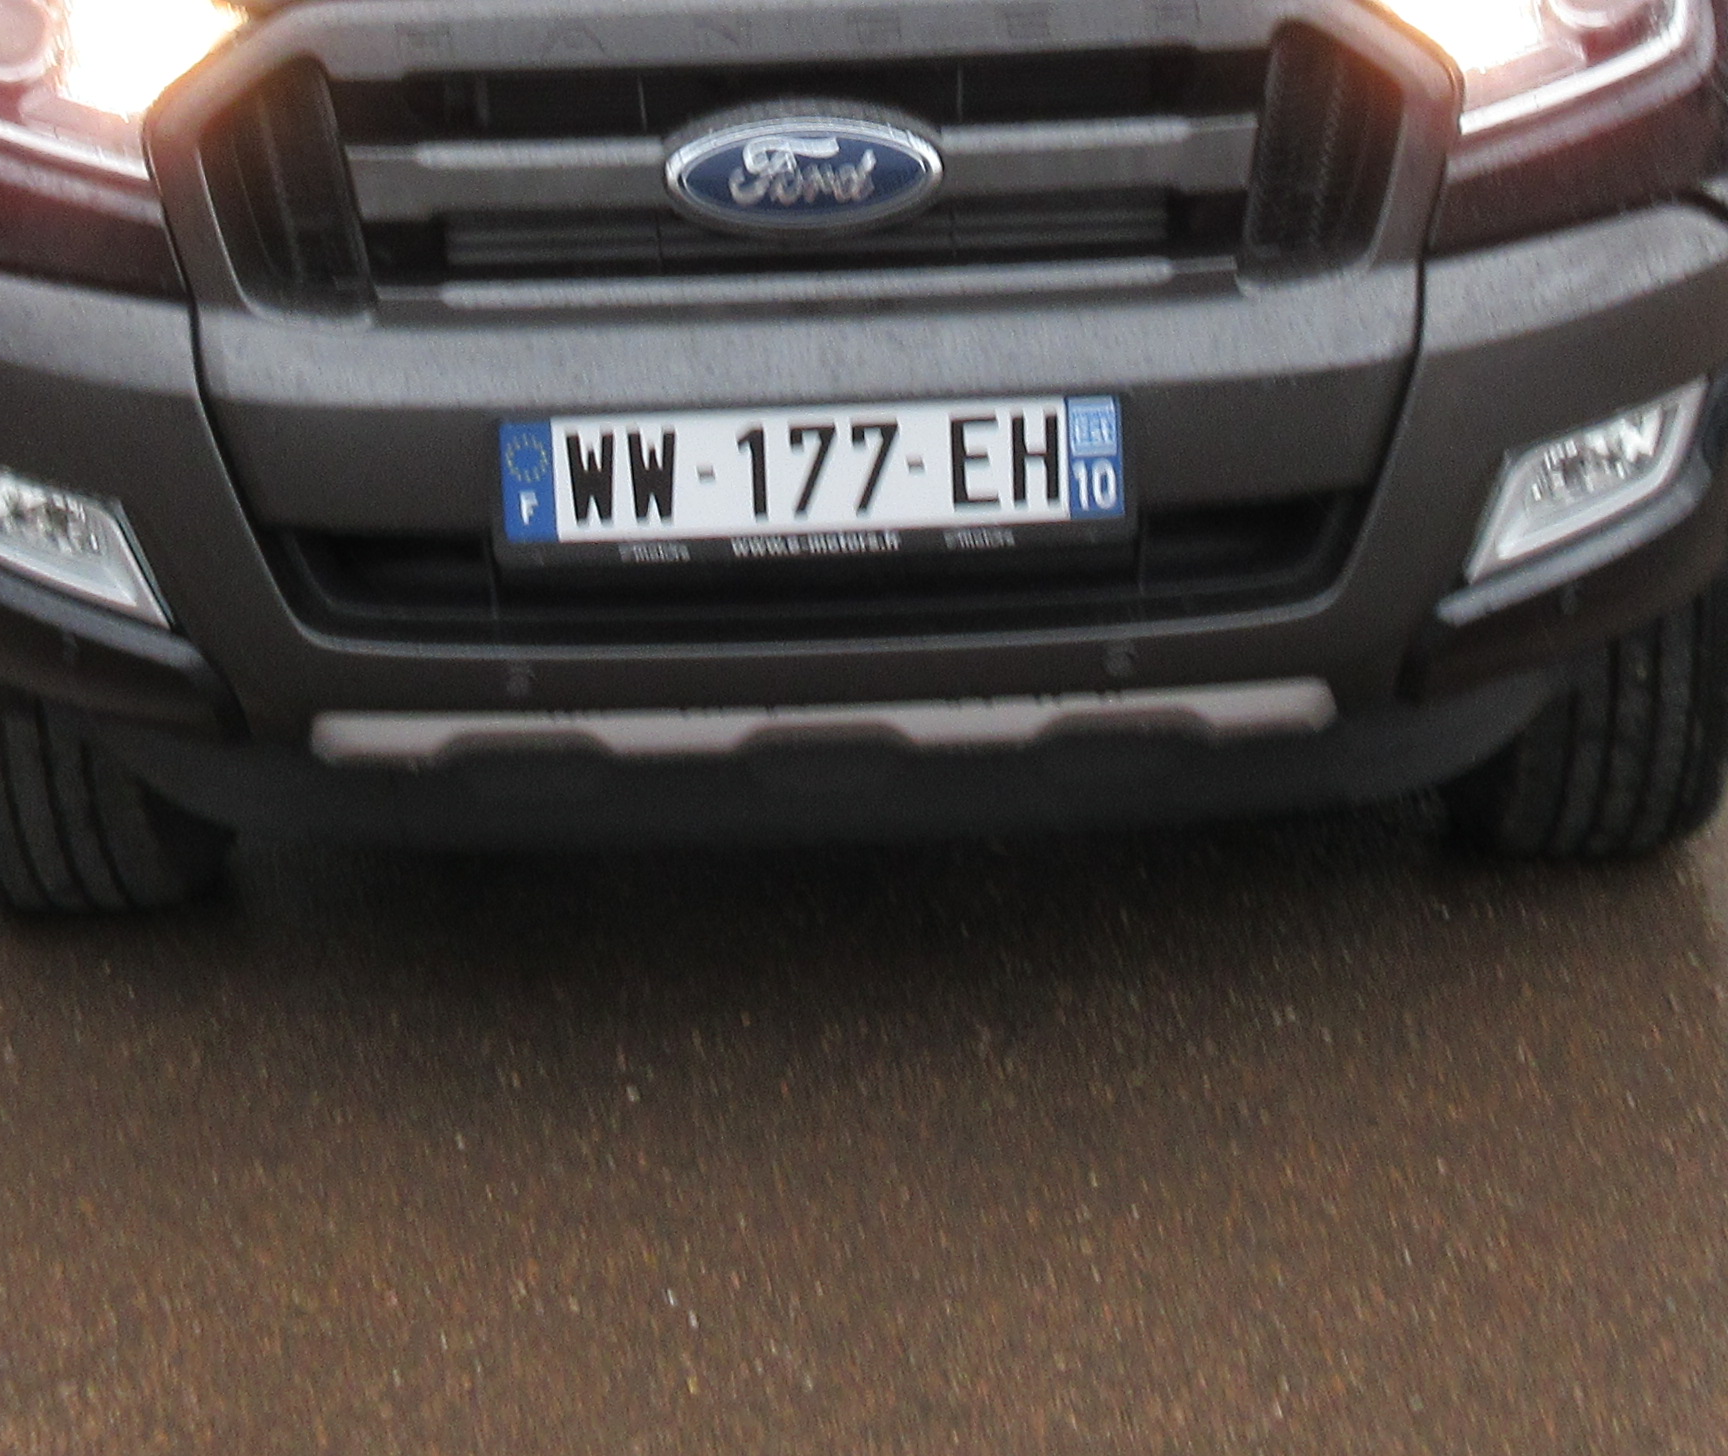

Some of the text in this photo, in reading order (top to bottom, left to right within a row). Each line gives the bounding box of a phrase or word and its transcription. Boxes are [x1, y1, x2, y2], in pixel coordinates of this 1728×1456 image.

[728, 136, 877, 206] Ford
[518, 490, 540, 525] F
[1072, 458, 1118, 511] 10
